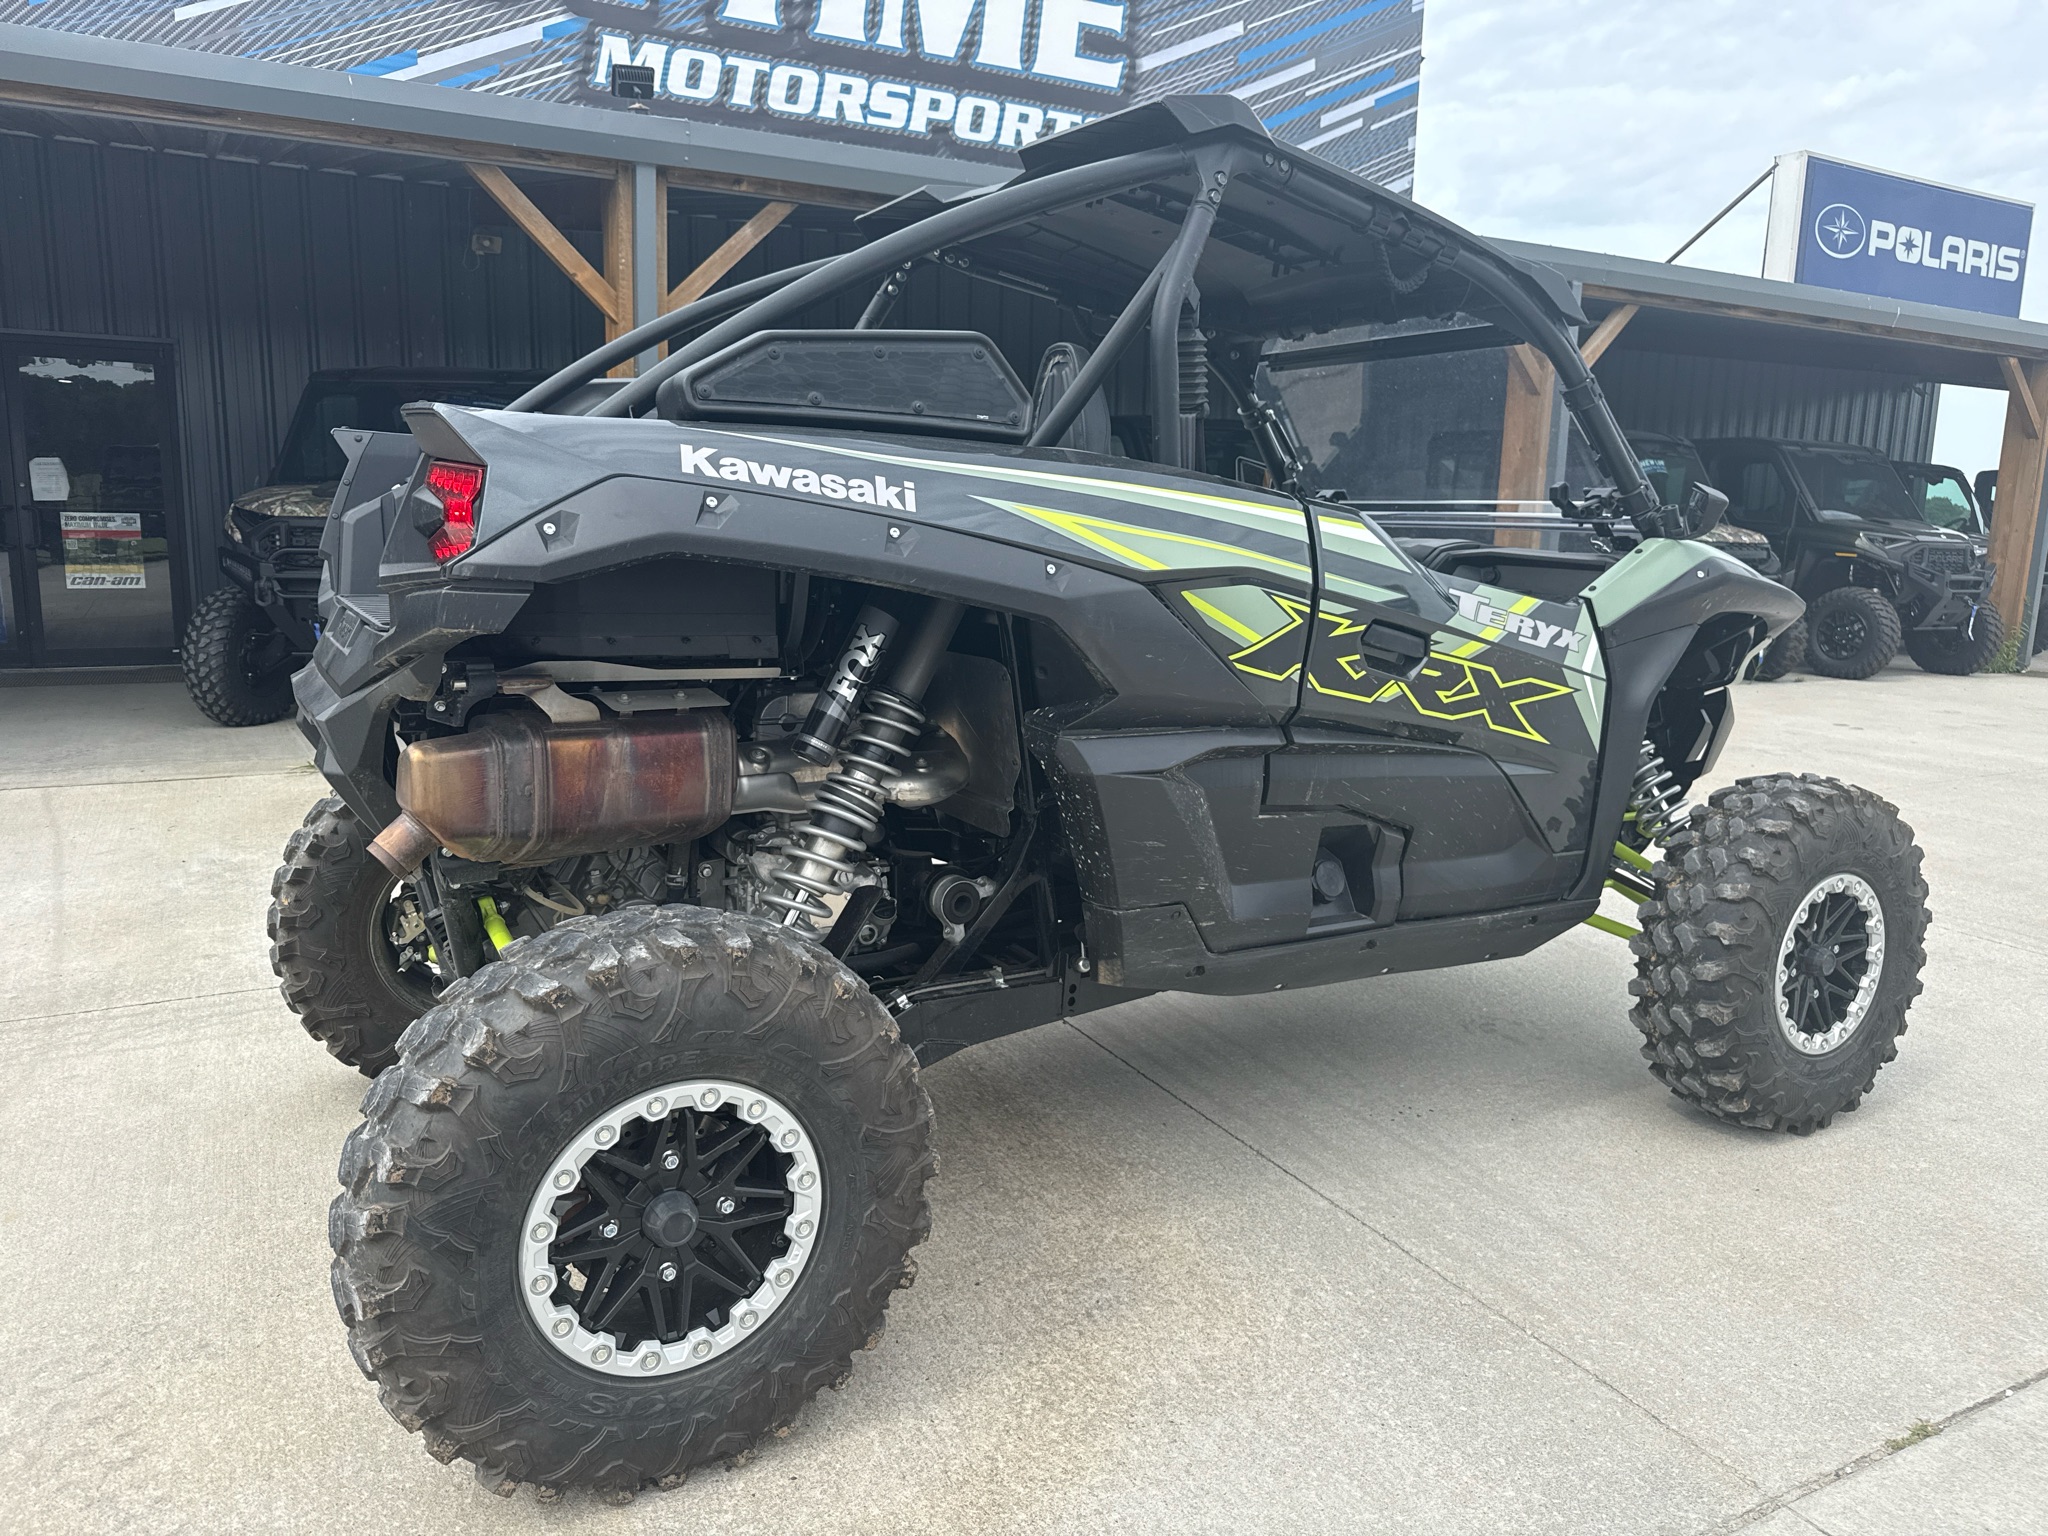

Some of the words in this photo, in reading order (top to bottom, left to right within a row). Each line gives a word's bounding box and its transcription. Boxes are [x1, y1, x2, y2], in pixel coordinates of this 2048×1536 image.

[715, 0, 1125, 90] ME
[594, 33, 1100, 148] MOTORSPORT
[1867, 219, 2021, 282] POLARIS
[679, 443, 917, 513] Kawasaki
[70, 576, 141, 585] can-am
[826, 622, 887, 703] FOX
